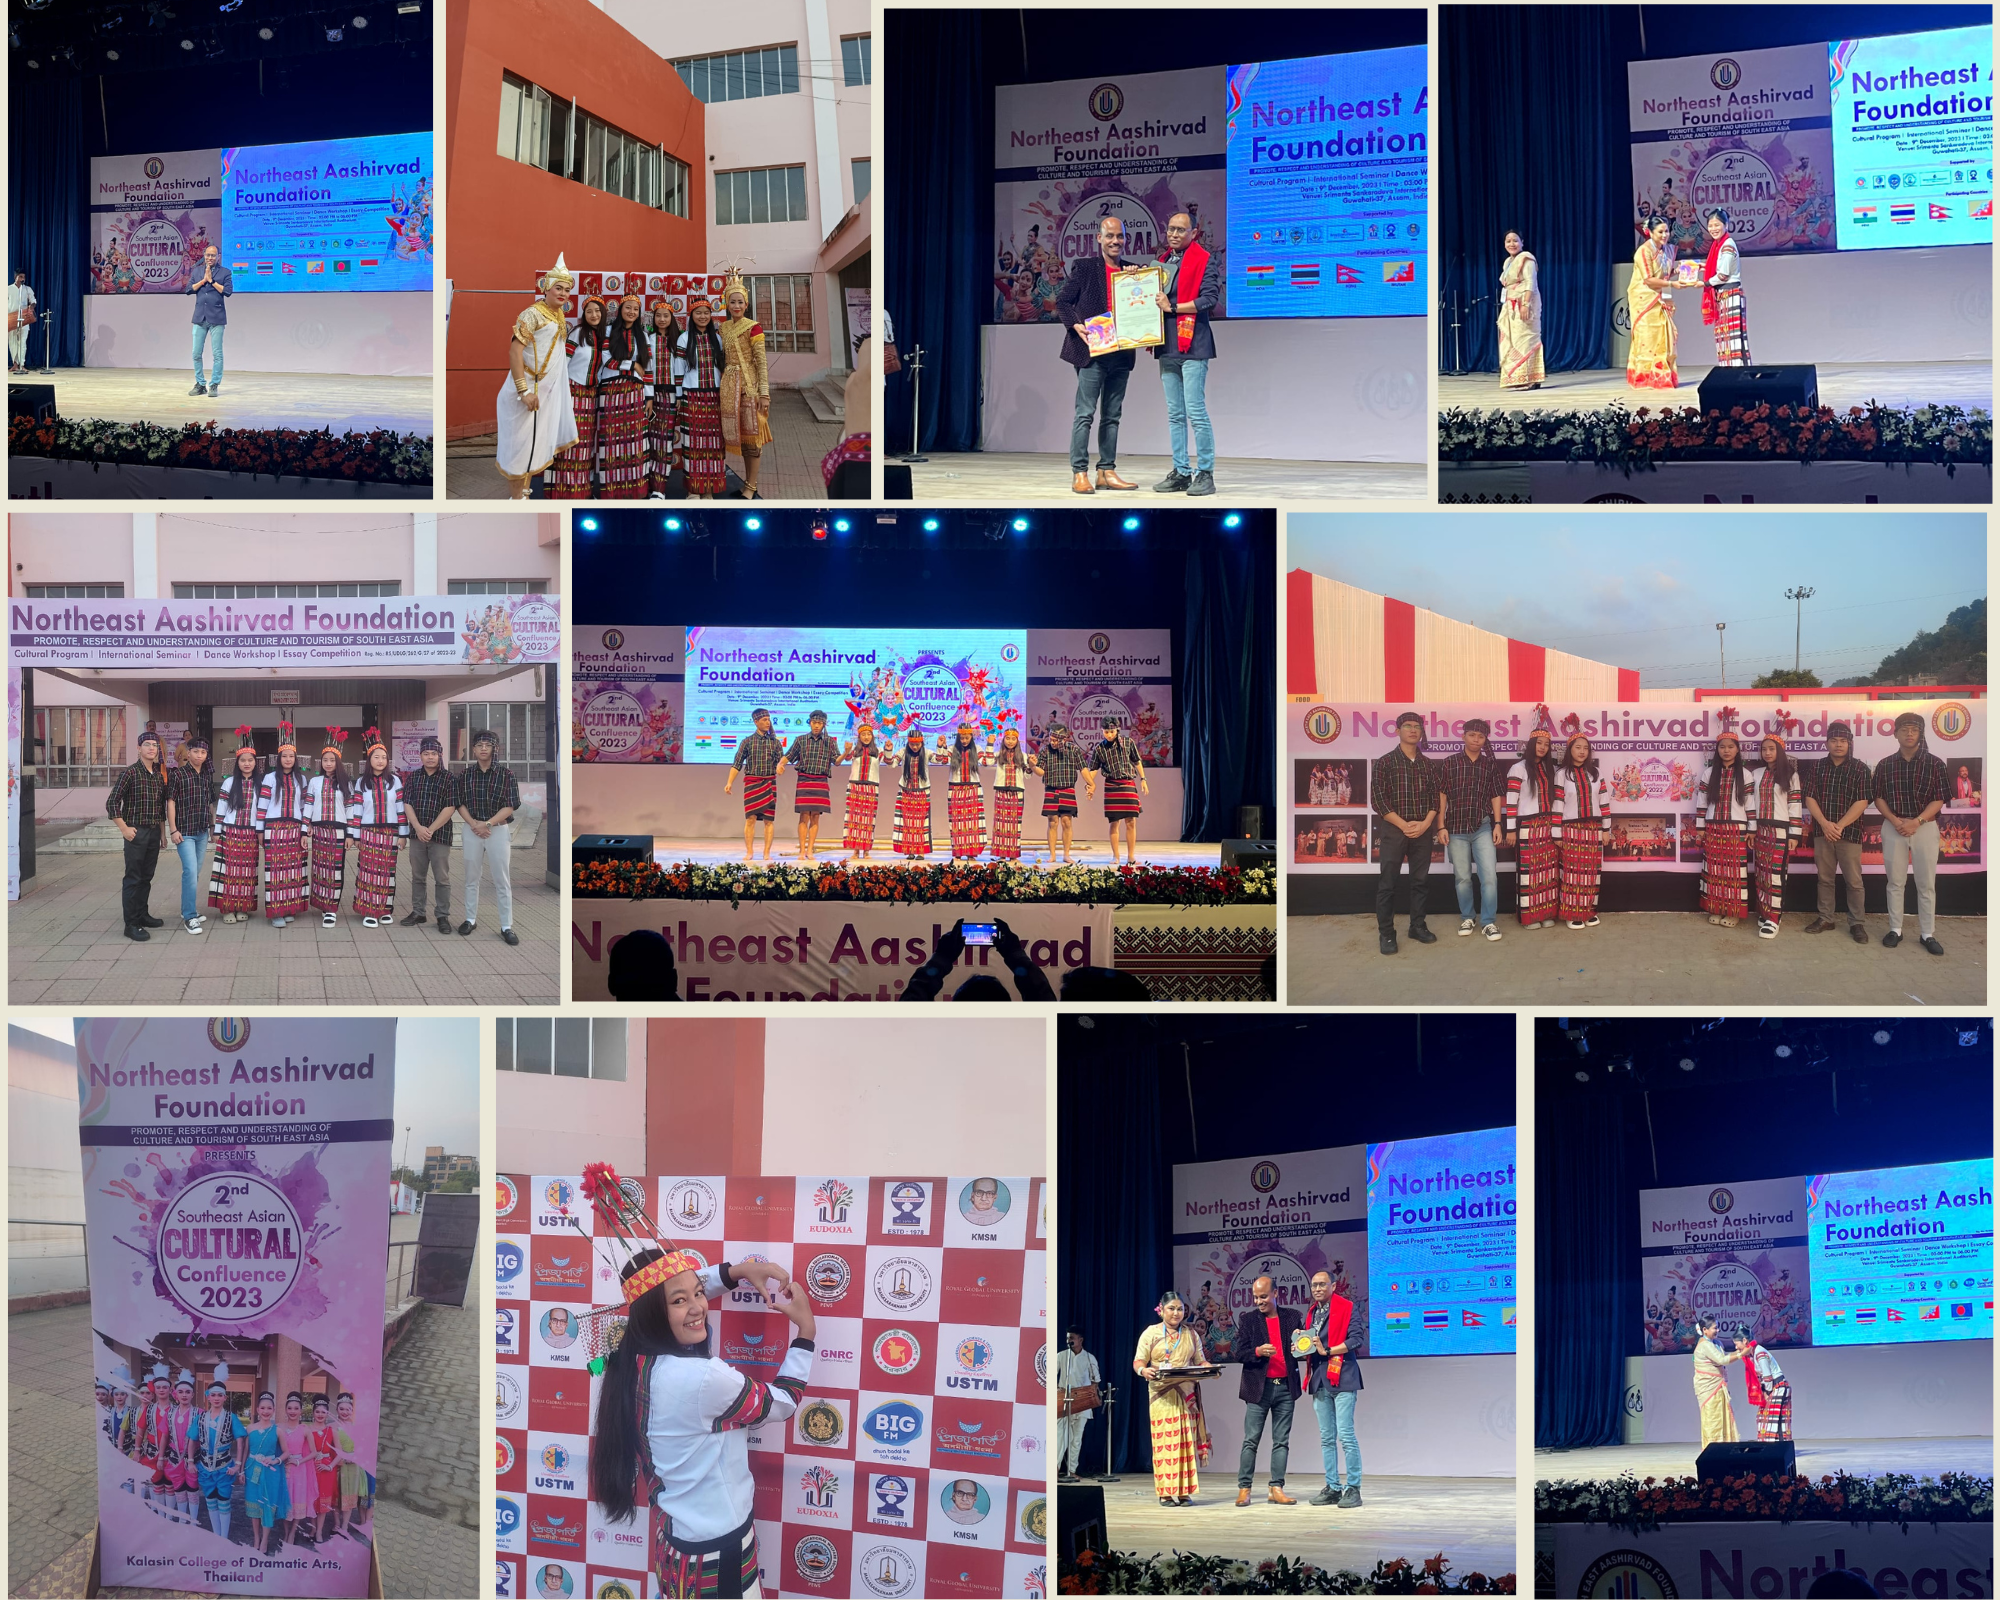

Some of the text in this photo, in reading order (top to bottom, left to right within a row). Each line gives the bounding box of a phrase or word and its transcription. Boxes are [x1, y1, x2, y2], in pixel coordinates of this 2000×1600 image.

[1852, 63, 1978, 94] Northeast
[1644, 85, 1813, 114] Northeast Aashirvad
[1253, 92, 1402, 128] Northeast
[1682, 107, 1773, 126] Foundation
[1010, 116, 1206, 148] Northeast Aashirvad
[1054, 141, 1159, 163] Foundation
[1253, 127, 1425, 163] Foundation
[236, 157, 420, 184] Northeast Aashirvad
[1114, 160, 1167, 168] UNDERSTANDING
[1250, 178, 1275, 187] Cultural
[1277, 177, 1305, 185] Program
[1314, 174, 1357, 183] International
[1702, 171, 1766, 182] Southeast Asian
[100, 177, 210, 193] Northeast Aashirvad
[125, 190, 184, 202] Foundation
[236, 186, 331, 204] Foundation
[1695, 181, 1775, 205] CULTURAL
[130, 242, 184, 256] CULTURAL
[144, 268, 168, 277] 2023
[12, 603, 455, 632] Northeast Aashirvad Foundation
[513, 622, 560, 633] CULTURAL
[34, 637, 80, 646] PROMOTE,
[83, 637, 123, 646] RESPECT
[126, 638, 144, 646] AND
[148, 638, 221, 646] UNDERSTANDING
[238, 637, 278, 645] CULTURE
[280, 637, 298, 645] AND
[342, 636, 353, 644] OF
[357, 636, 386, 644] SOUTH
[414, 635, 434, 643] ASIA
[15, 649, 361, 660] Cultural Program International Seminar Dance Workshop Essay Competition
[613, 652, 673, 662] Aashirvad
[700, 648, 876, 664] Northeast Aashirvad
[1038, 655, 1160, 666] Northeast Aashirvad
[580, 662, 645, 672] Foundation
[700, 667, 795, 681] Foundation
[1066, 666, 1132, 676] Foundation
[904, 688, 959, 700] CULTURAL
[585, 713, 643, 726] CULTURAL
[920, 712, 945, 721] 2023
[590, 729, 637, 737] Confluence
[600, 738, 627, 747] 2023
[90, 1053, 374, 1087] Northeast Aashirvad
[154, 1091, 306, 1118] Foundation
[131, 1124, 331, 1136] PROMOTE, RESPECT AND UNDERSTANDING OF
[175, 1136, 193, 1144] AND
[195, 1135, 234, 1144] TOURISM
[237, 1135, 248, 1143] OF
[251, 1134, 281, 1143] SOUTH
[283, 1134, 306, 1142] EAST
[309, 1133, 329, 1141] ASIA
[205, 1150, 256, 1161] PRESENTS
[1389, 1164, 1515, 1196] Northeast
[215, 1183, 249, 1205] 2nd
[1186, 1187, 1350, 1216] Northeast Aashirvad
[1825, 1194, 1927, 1218] Northeast
[177, 1209, 285, 1224] Southeast Asian
[539, 1216, 579, 1227] USTM
[1222, 1211, 1311, 1228] Foundation
[1652, 1210, 1793, 1233] Northeast Aashirvad
[1685, 1229, 1761, 1243] Foundation
[1826, 1217, 1945, 1242] Foundation
[164, 1228, 297, 1260] CULTURAL
[177, 1265, 286, 1283] Confluence
[1280, 1275, 1302, 1283] Asian
[1701, 1280, 1734, 1290] Southeast
[200, 1286, 263, 1308] 2023
[1694, 1288, 1762, 1308] CULTURAL
[821, 1350, 853, 1360] GNRC
[946, 1377, 998, 1391] USTM
[875, 1414, 915, 1433] BIG
[884, 1432, 898, 1440] FM
[535, 1477, 574, 1491] USTM
[797, 1507, 839, 1519] EUDOXIA
[614, 1534, 643, 1544] GNRC
[954, 1531, 978, 1540] KMSM
[126, 1555, 342, 1571] Kalasin College of Dramatic Arts,
[1599, 1554, 1653, 1574] AASHIRVAD
[204, 1570, 264, 1583] Thailand
